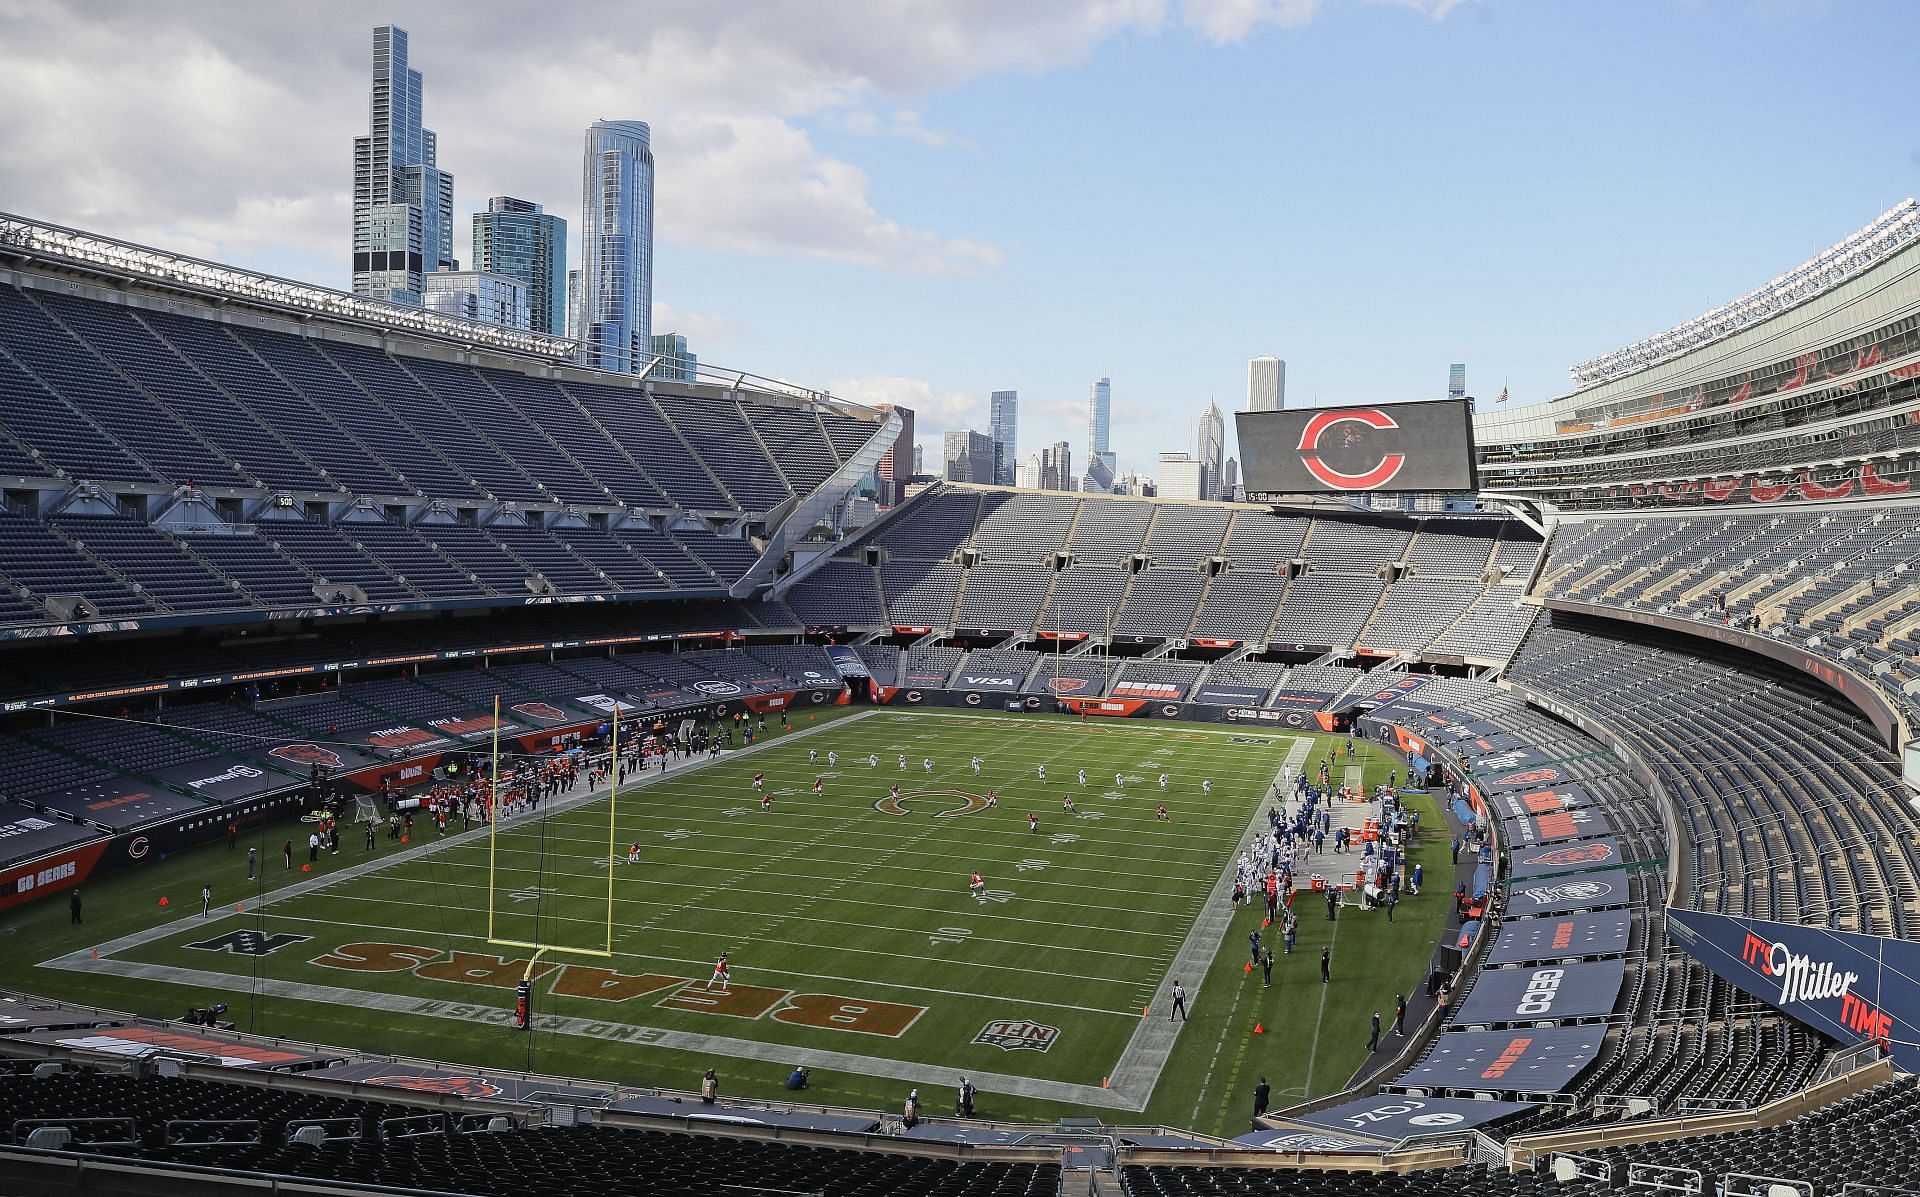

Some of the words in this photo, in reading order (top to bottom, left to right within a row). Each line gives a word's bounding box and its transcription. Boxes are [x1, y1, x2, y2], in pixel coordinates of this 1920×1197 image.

[964, 676, 1014, 686] VISA
[306, 942, 929, 1038] BEARS
[1516, 970, 1564, 1014] GEICO
[1742, 933, 1773, 976] IT'S
[1770, 942, 1858, 1005] Miller
[1840, 994, 1893, 1050] TIME
[582, 1024, 668, 1042] END
[994, 1023, 1052, 1041] NFL
[1480, 1038, 1532, 1079] BEARS
[1344, 1100, 1426, 1128] razr
